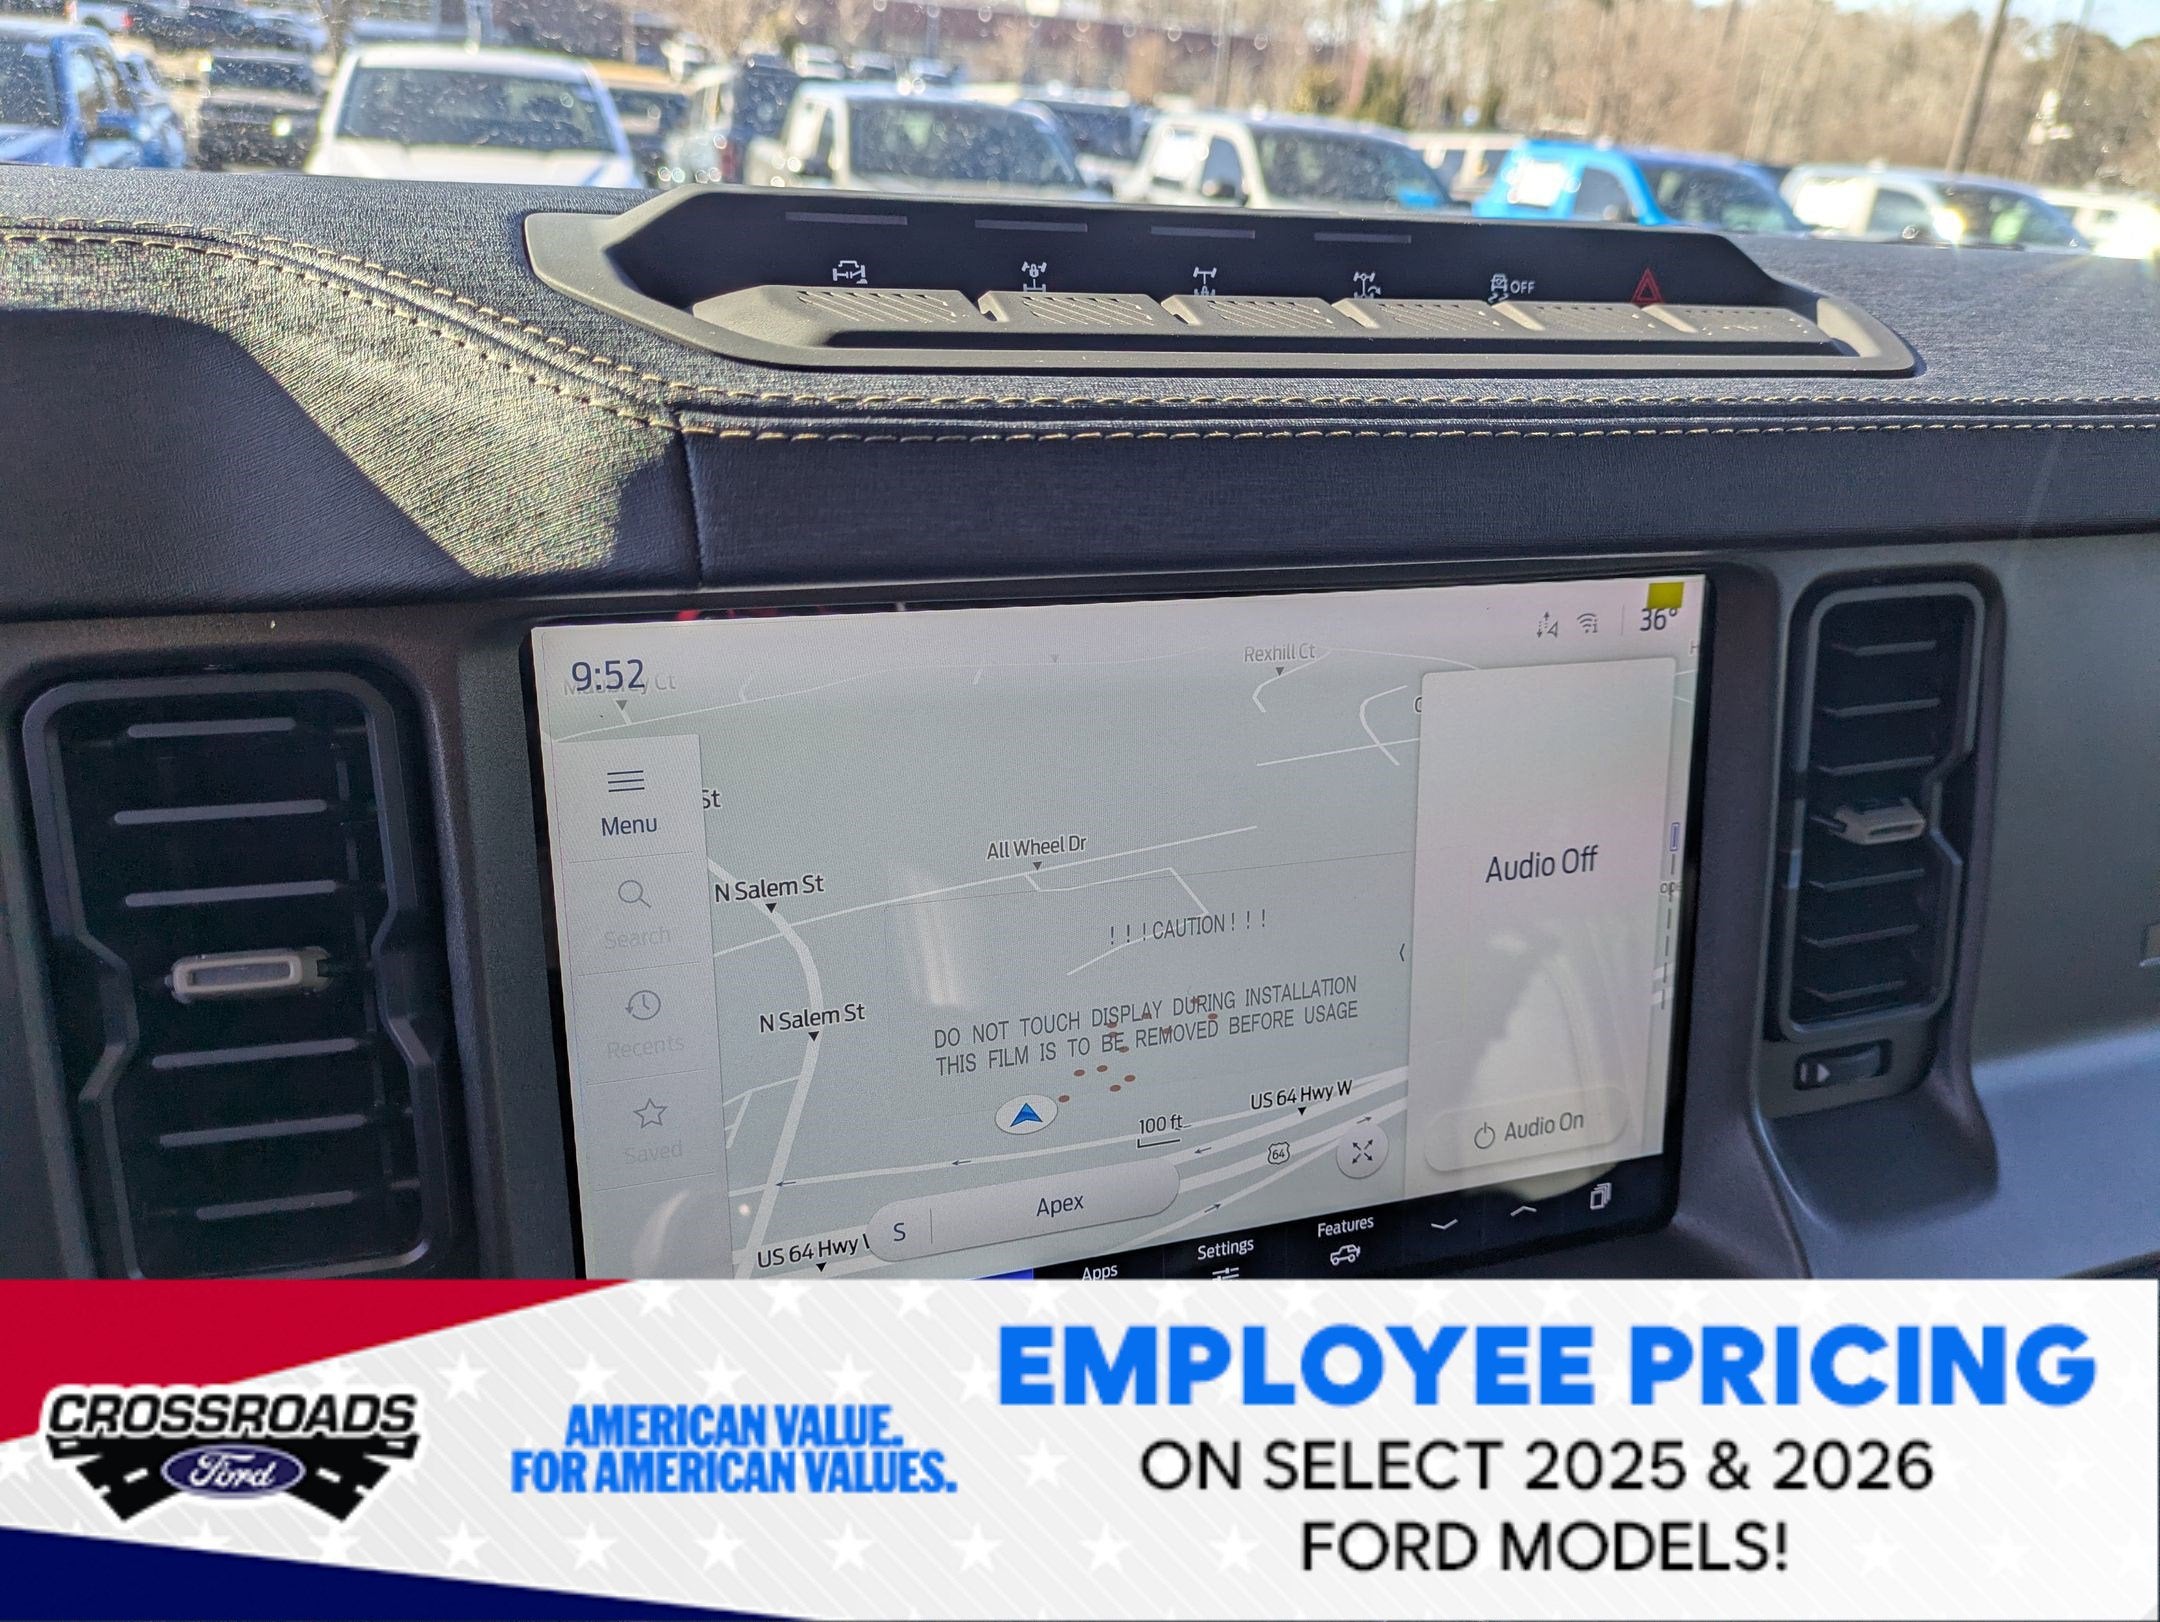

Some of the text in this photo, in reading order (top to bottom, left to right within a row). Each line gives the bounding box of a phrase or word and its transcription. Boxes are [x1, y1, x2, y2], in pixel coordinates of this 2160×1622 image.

[1510, 279, 1535, 295] OFF
[1243, 642, 1316, 663] Rexhill Ct
[571, 659, 646, 691] 9:52
[601, 816, 658, 837] Menu
[986, 834, 1088, 861] All Wheel Dr
[1485, 845, 1599, 884] Audio Off
[714, 873, 825, 903] N Salem St
[604, 926, 672, 949] Search
[759, 1002, 866, 1033] N Salem St
[934, 975, 1358, 1049] DO NOT TOUCH DISPLAY DURING INSTALLATION
[606, 1035, 685, 1060] Recents
[936, 1000, 1359, 1077] THIS FILM IS TO BE REMOVED BEFORE USAGE
[1251, 1079, 1353, 1110] US 64 Hwy W
[1138, 1114, 1183, 1135] 100 ft
[1503, 1110, 1585, 1142] Audio On
[624, 1140, 683, 1165] Saved
[1271, 1148, 1285, 1160] 64
[1036, 1194, 1085, 1218] Apex
[893, 1222, 906, 1242] S
[1316, 1213, 1374, 1238] Features
[757, 1248, 785, 1268] US
[789, 1242, 815, 1263] 64
[817, 1234, 860, 1258] Hwy
[1197, 1236, 1255, 1263] Settings
[1082, 1263, 1119, 1280] Apps
